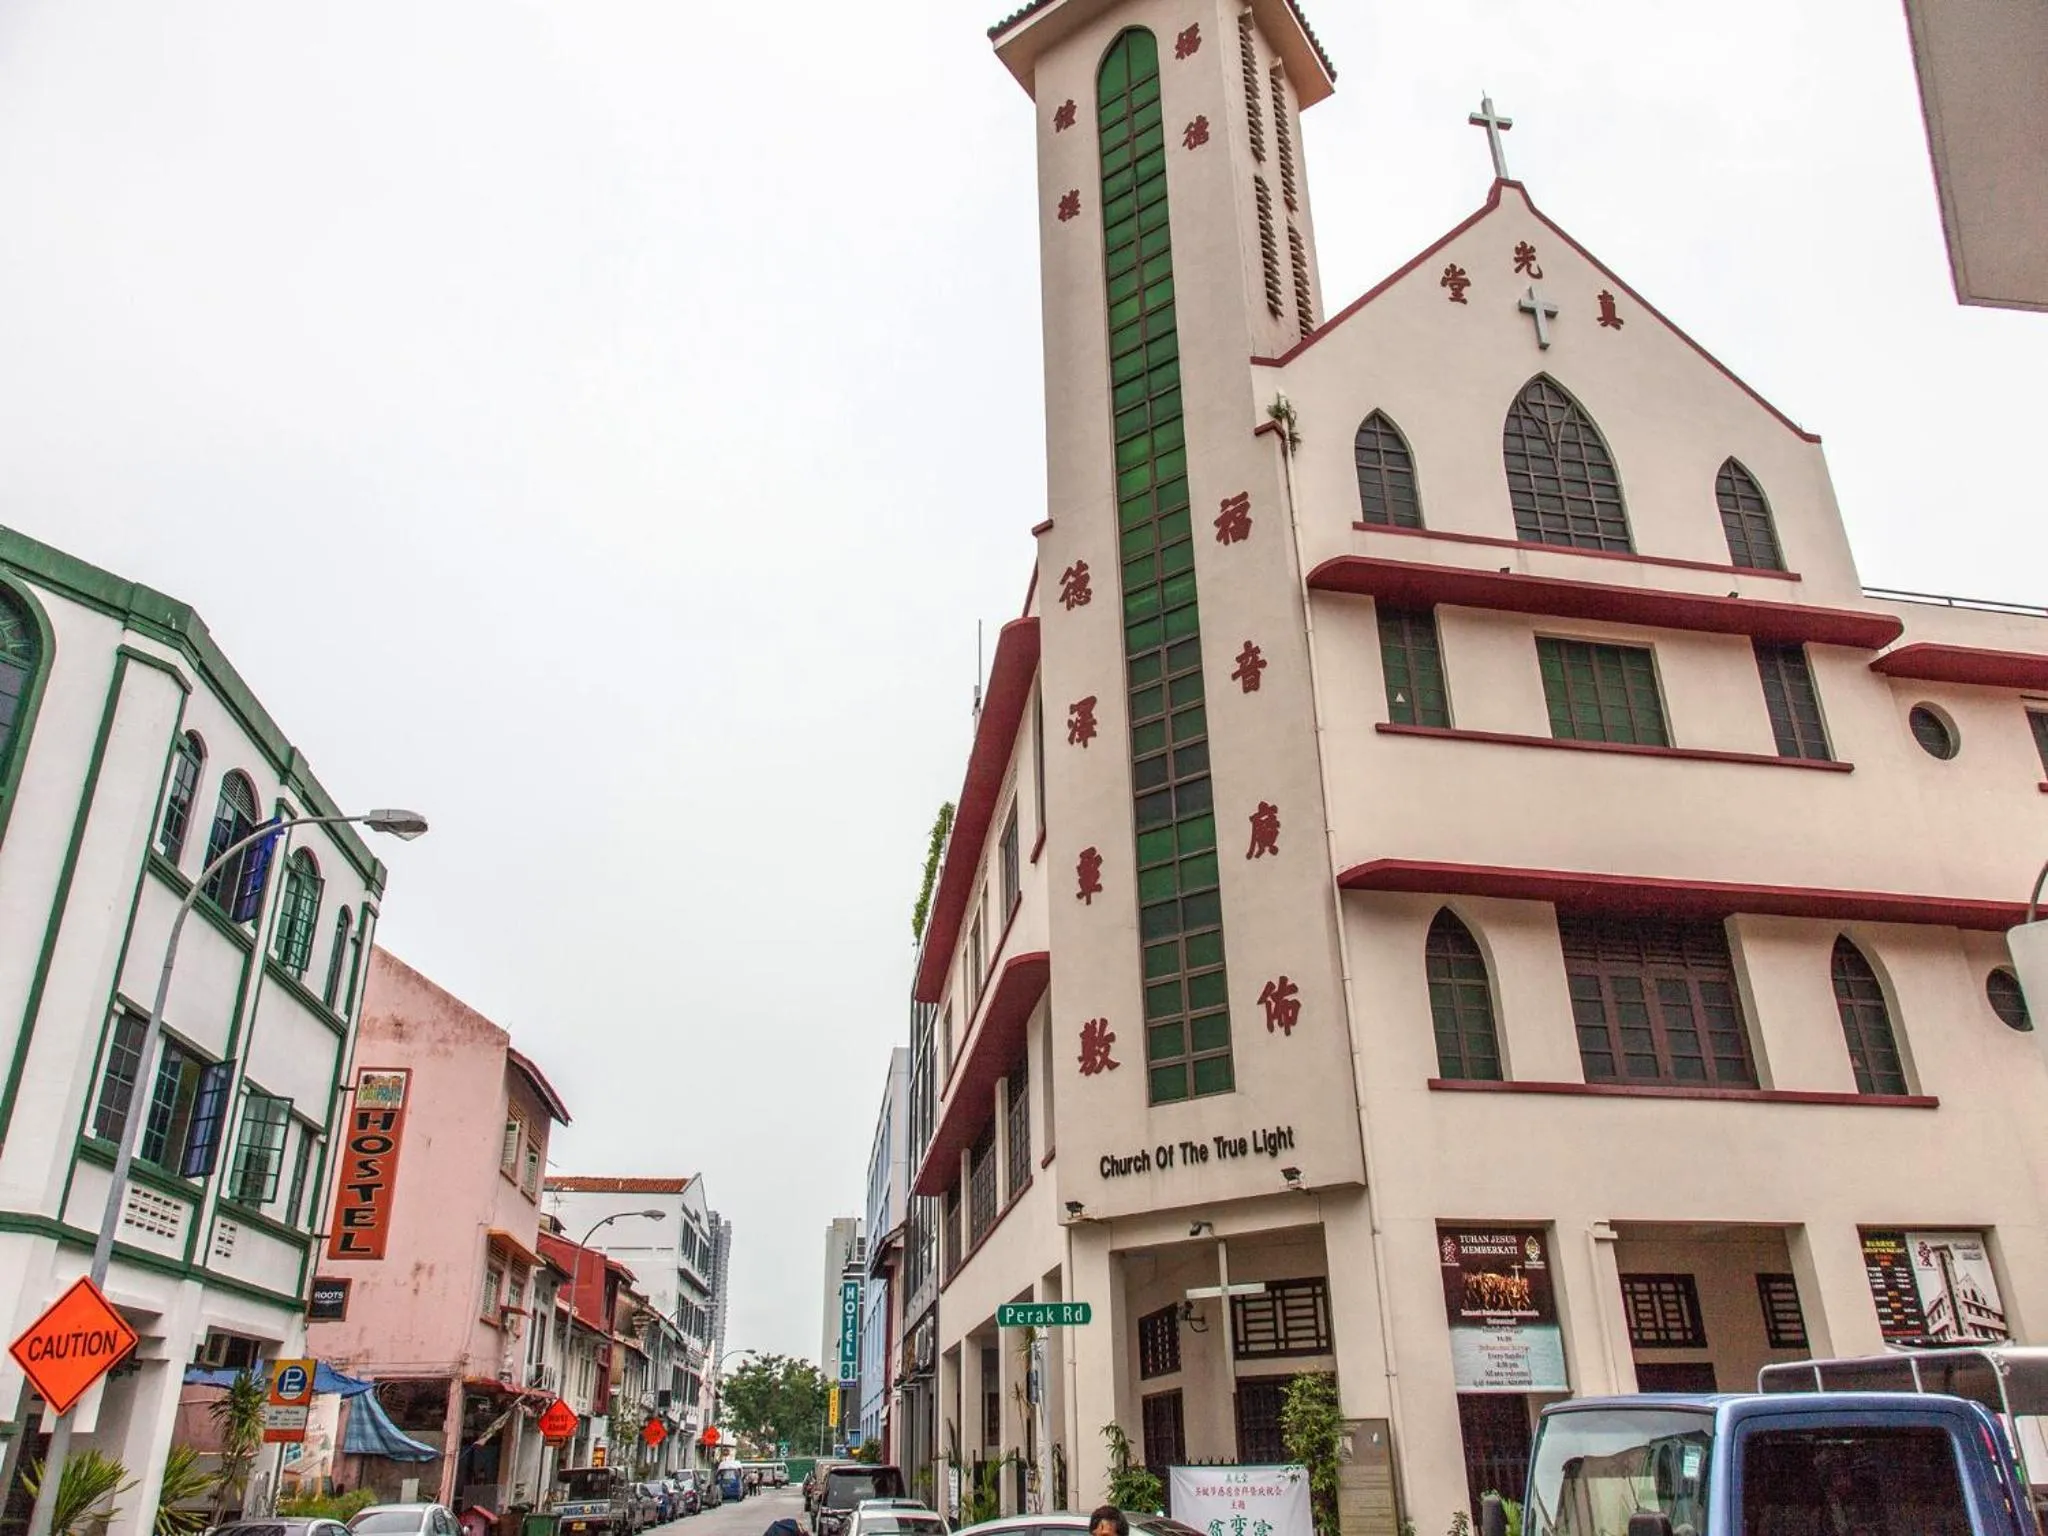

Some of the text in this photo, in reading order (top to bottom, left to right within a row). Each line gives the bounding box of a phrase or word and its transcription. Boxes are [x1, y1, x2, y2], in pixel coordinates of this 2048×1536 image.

[1099, 1126, 1295, 1179] Church Of The True Light
[340, 1111, 398, 1254] HOSTEL
[1460, 1235, 1489, 1244] TUHAN
[1461, 1245, 1518, 1254] MEMBERKATI
[844, 1286, 856, 1357] HOTEL
[1006, 1305, 1083, 1324] Perak Rd
[28, 1330, 118, 1362] CAUTION
[840, 1363, 856, 1380] 81
